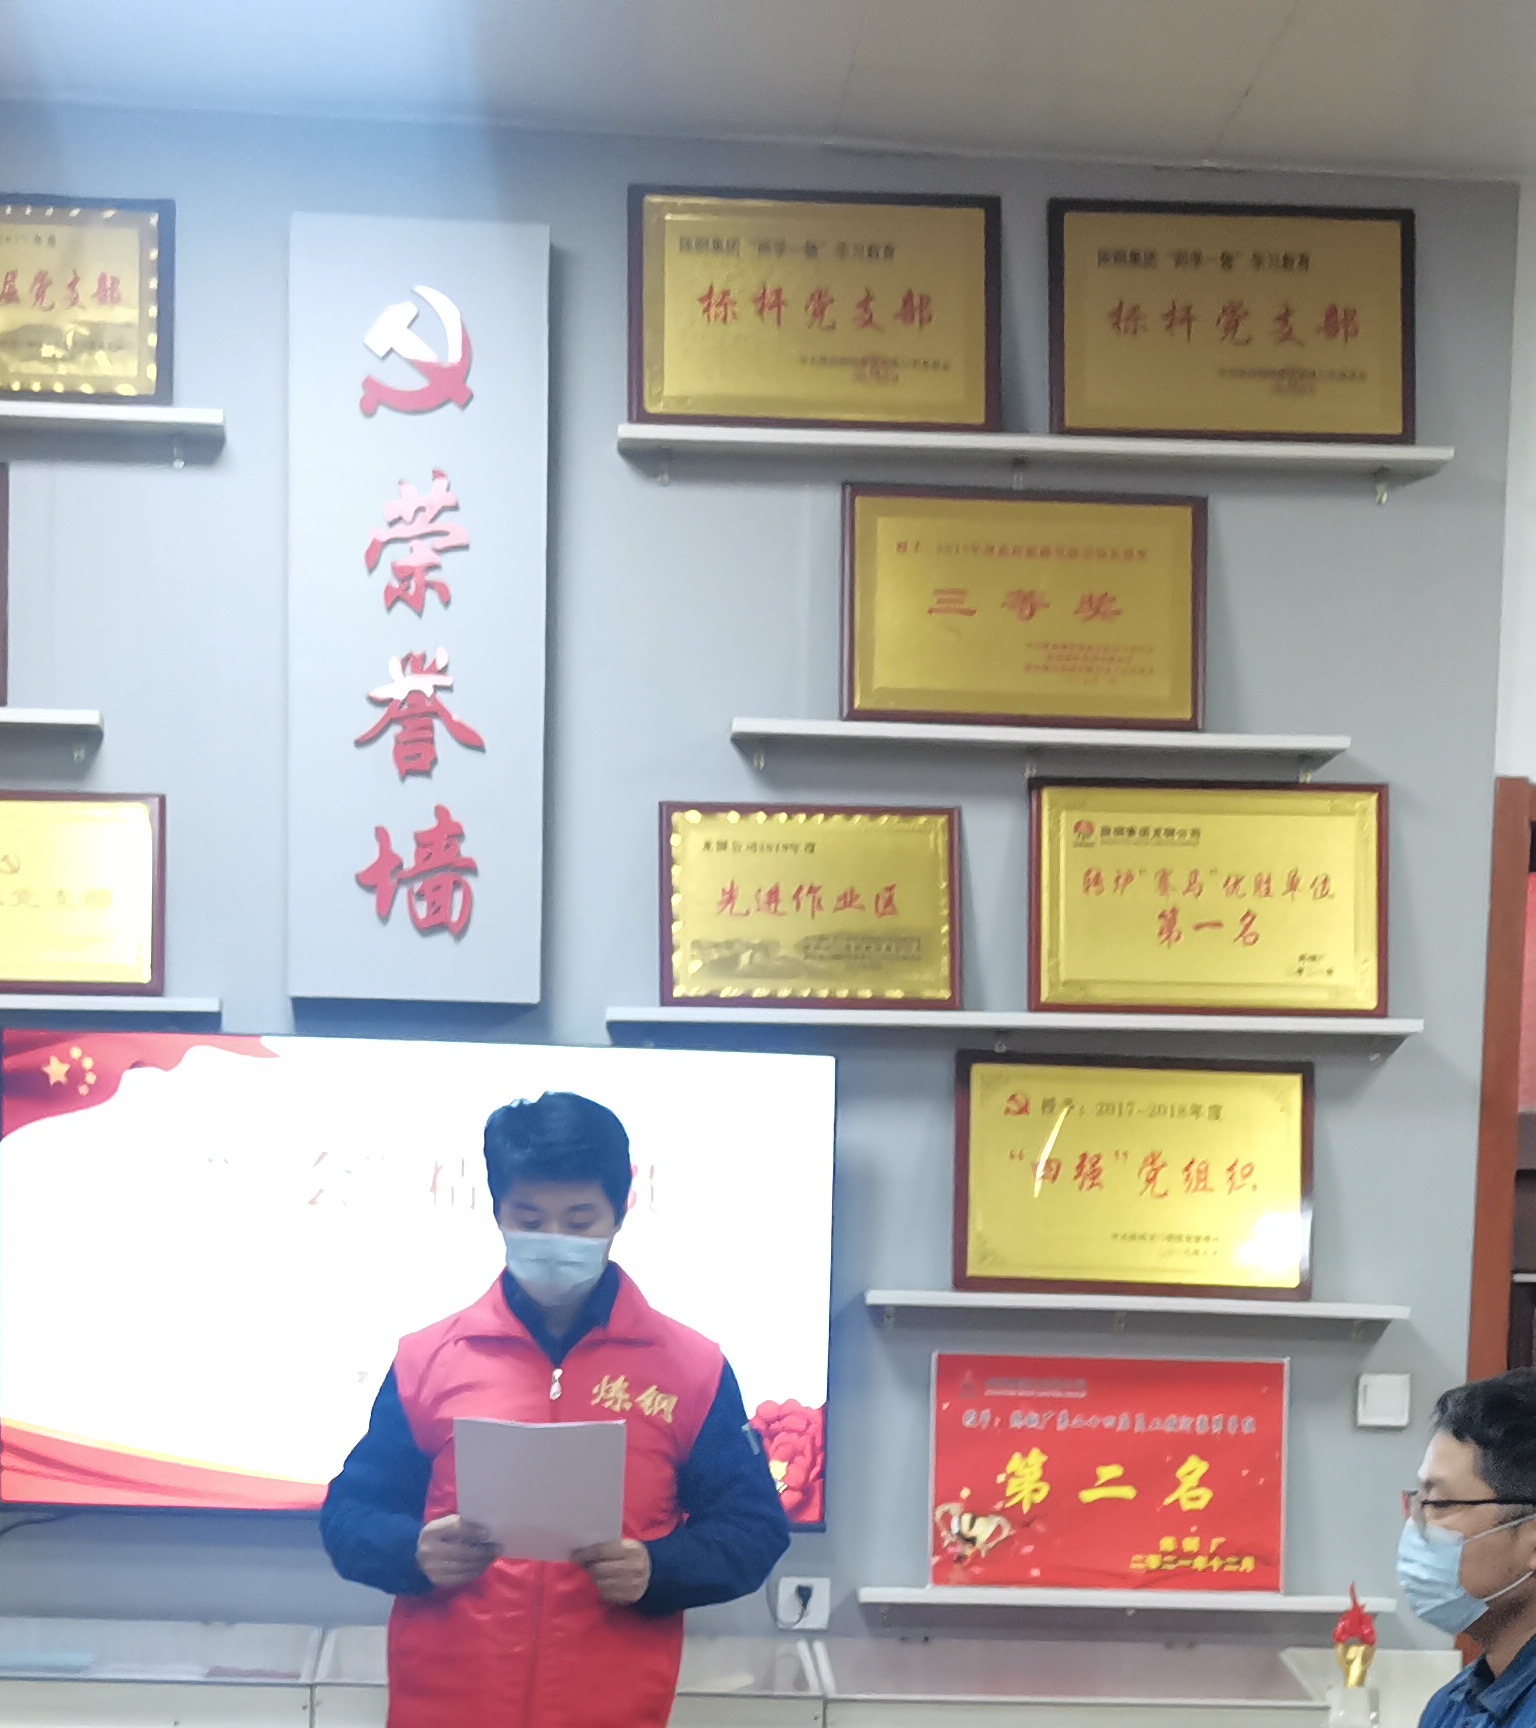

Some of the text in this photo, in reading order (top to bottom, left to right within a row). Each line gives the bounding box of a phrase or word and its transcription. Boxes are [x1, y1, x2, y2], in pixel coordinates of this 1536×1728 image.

[698, 282, 934, 331] 标杆党支部
[1108, 300, 1361, 347] 标杆党支部
[927, 587, 1123, 623] 三等奖
[355, 469, 485, 941] 荣誉墙
[717, 878, 899, 920] 先进作业区
[1157, 906, 1260, 949] 第一名
[590, 1374, 679, 1424] 炼钢
[1005, 1446, 1214, 1514] 第二名
